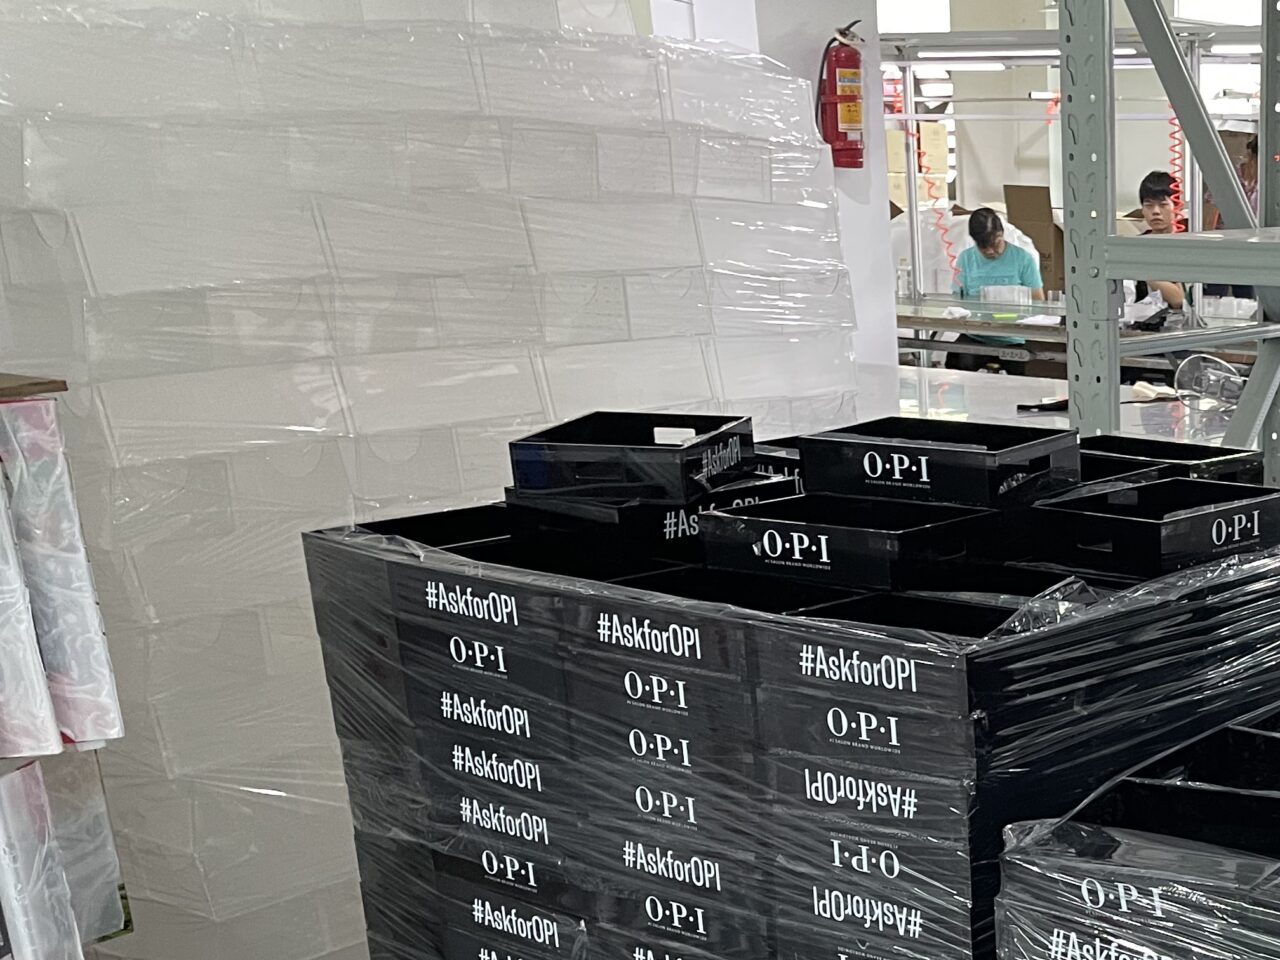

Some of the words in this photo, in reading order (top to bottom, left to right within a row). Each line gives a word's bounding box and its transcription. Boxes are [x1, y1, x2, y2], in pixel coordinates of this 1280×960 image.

[702, 435, 741, 478] #AskforOPI
[863, 451, 930, 482] O·P·I
[763, 530, 830, 562] O·P·I
[1212, 510, 1260, 546] O·P·I
[426, 581, 518, 626] #AskforOPI
[449, 637, 508, 672] O·P·I
[597, 612, 701, 659] #AskforOPI
[799, 644, 917, 692] #AskforOPI
[624, 670, 688, 708] O·P·I
[440, 691, 530, 738] #AskforOPI
[827, 707, 901, 746] O·P·I
[452, 744, 542, 791] #AskforOPI
[629, 729, 692, 767] O·P·I
[635, 786, 698, 824] O·P·I
[804, 769, 918, 819] #AskforOPI
[460, 797, 549, 844] #AskforOPI
[482, 849, 536, 887] O·P·I
[623, 840, 721, 891] #AskforOPI
[831, 839, 900, 878] O·P·I
[472, 898, 560, 948] #AskforOPI
[645, 896, 707, 934] O·P·I
[812, 886, 922, 938] #AskforOPI
